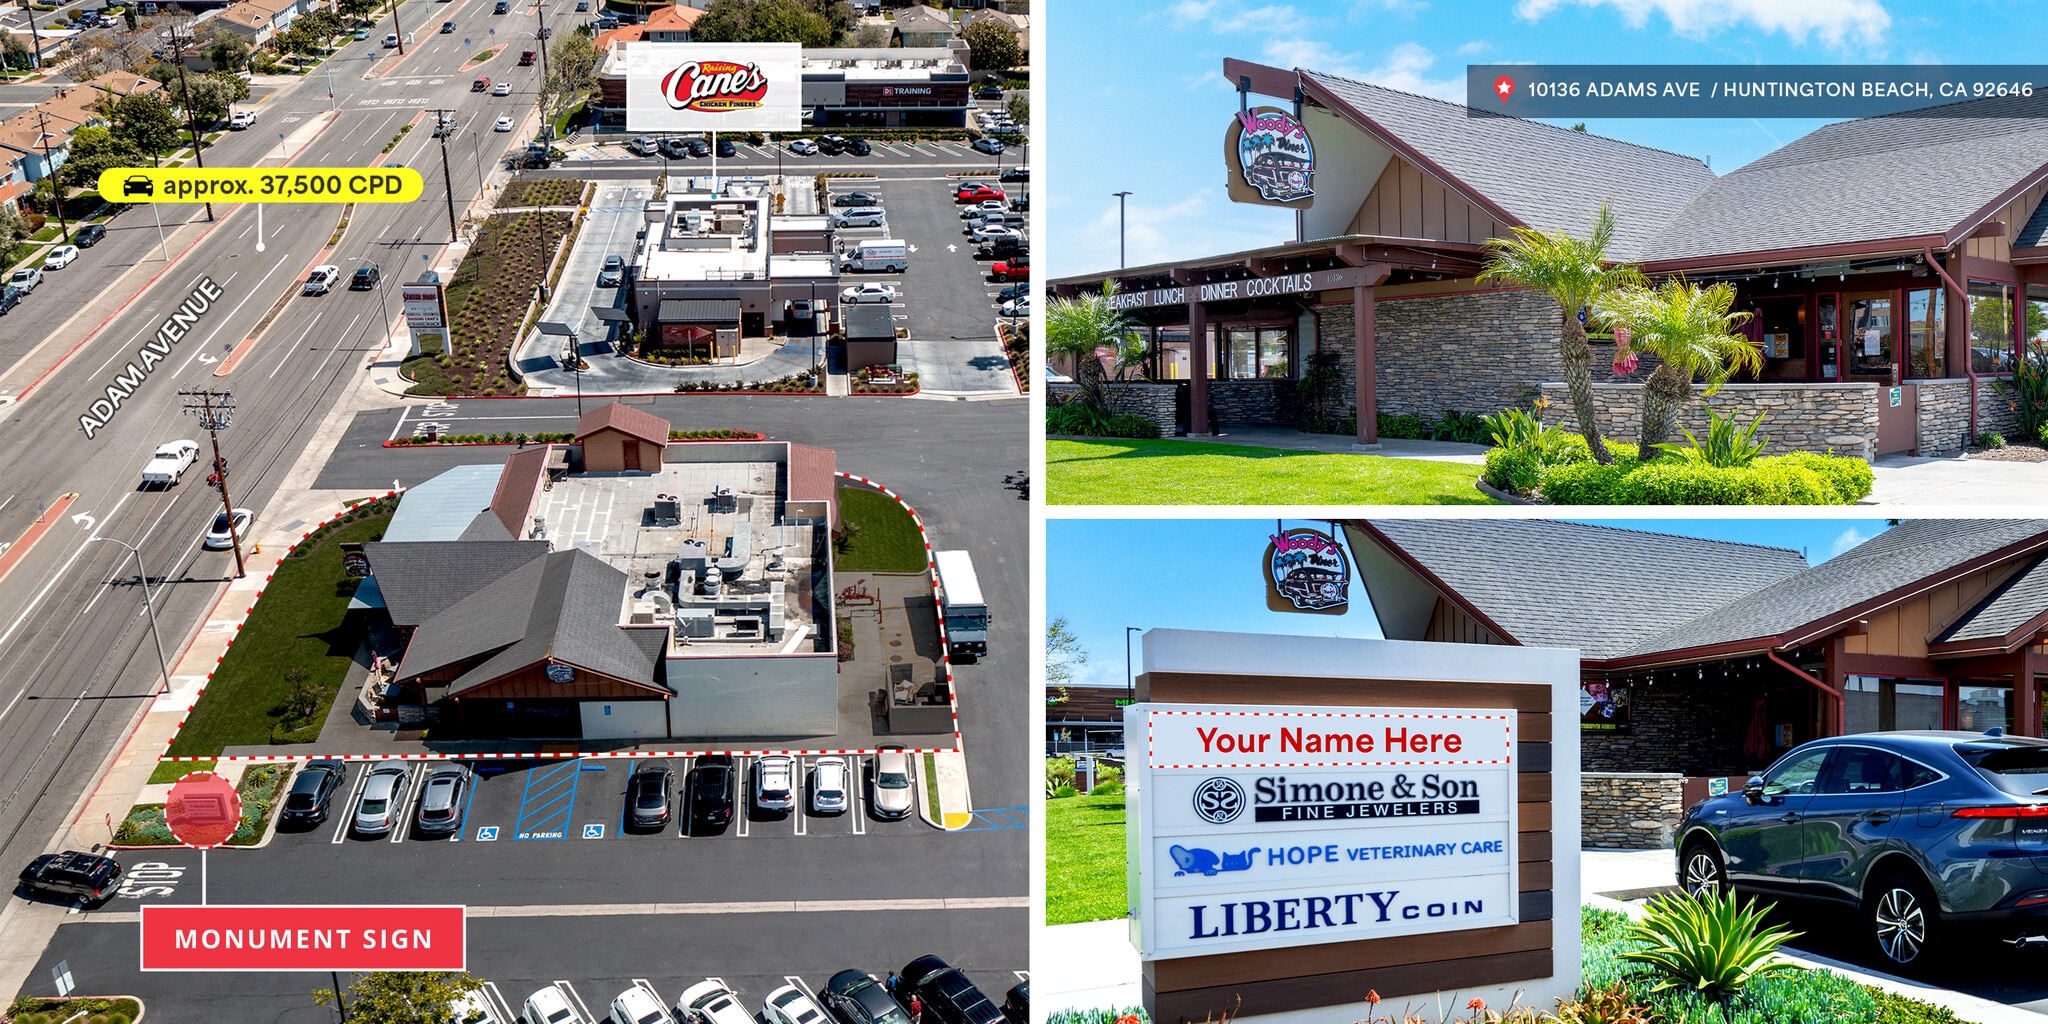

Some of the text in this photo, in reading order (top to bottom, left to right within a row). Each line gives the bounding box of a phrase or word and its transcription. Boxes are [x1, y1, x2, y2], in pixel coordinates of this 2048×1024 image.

[1237, 107, 1305, 139] Woody's
[1276, 137, 1307, 153] Diner
[1106, 273, 1313, 310] EAKFAST LUNCH DINNER COCKTAILS
[1269, 530, 1338, 555] Woody's
[1308, 553, 1339, 567] Diner
[1254, 773, 1479, 805] Simone & Son
[1282, 801, 1459, 820] FINE JEWELERS
[1268, 840, 1503, 867] HOPE VETERINARY CARE
[117, 862, 187, 897] STOP
[1189, 890, 1483, 940] LIBERTY COIN
